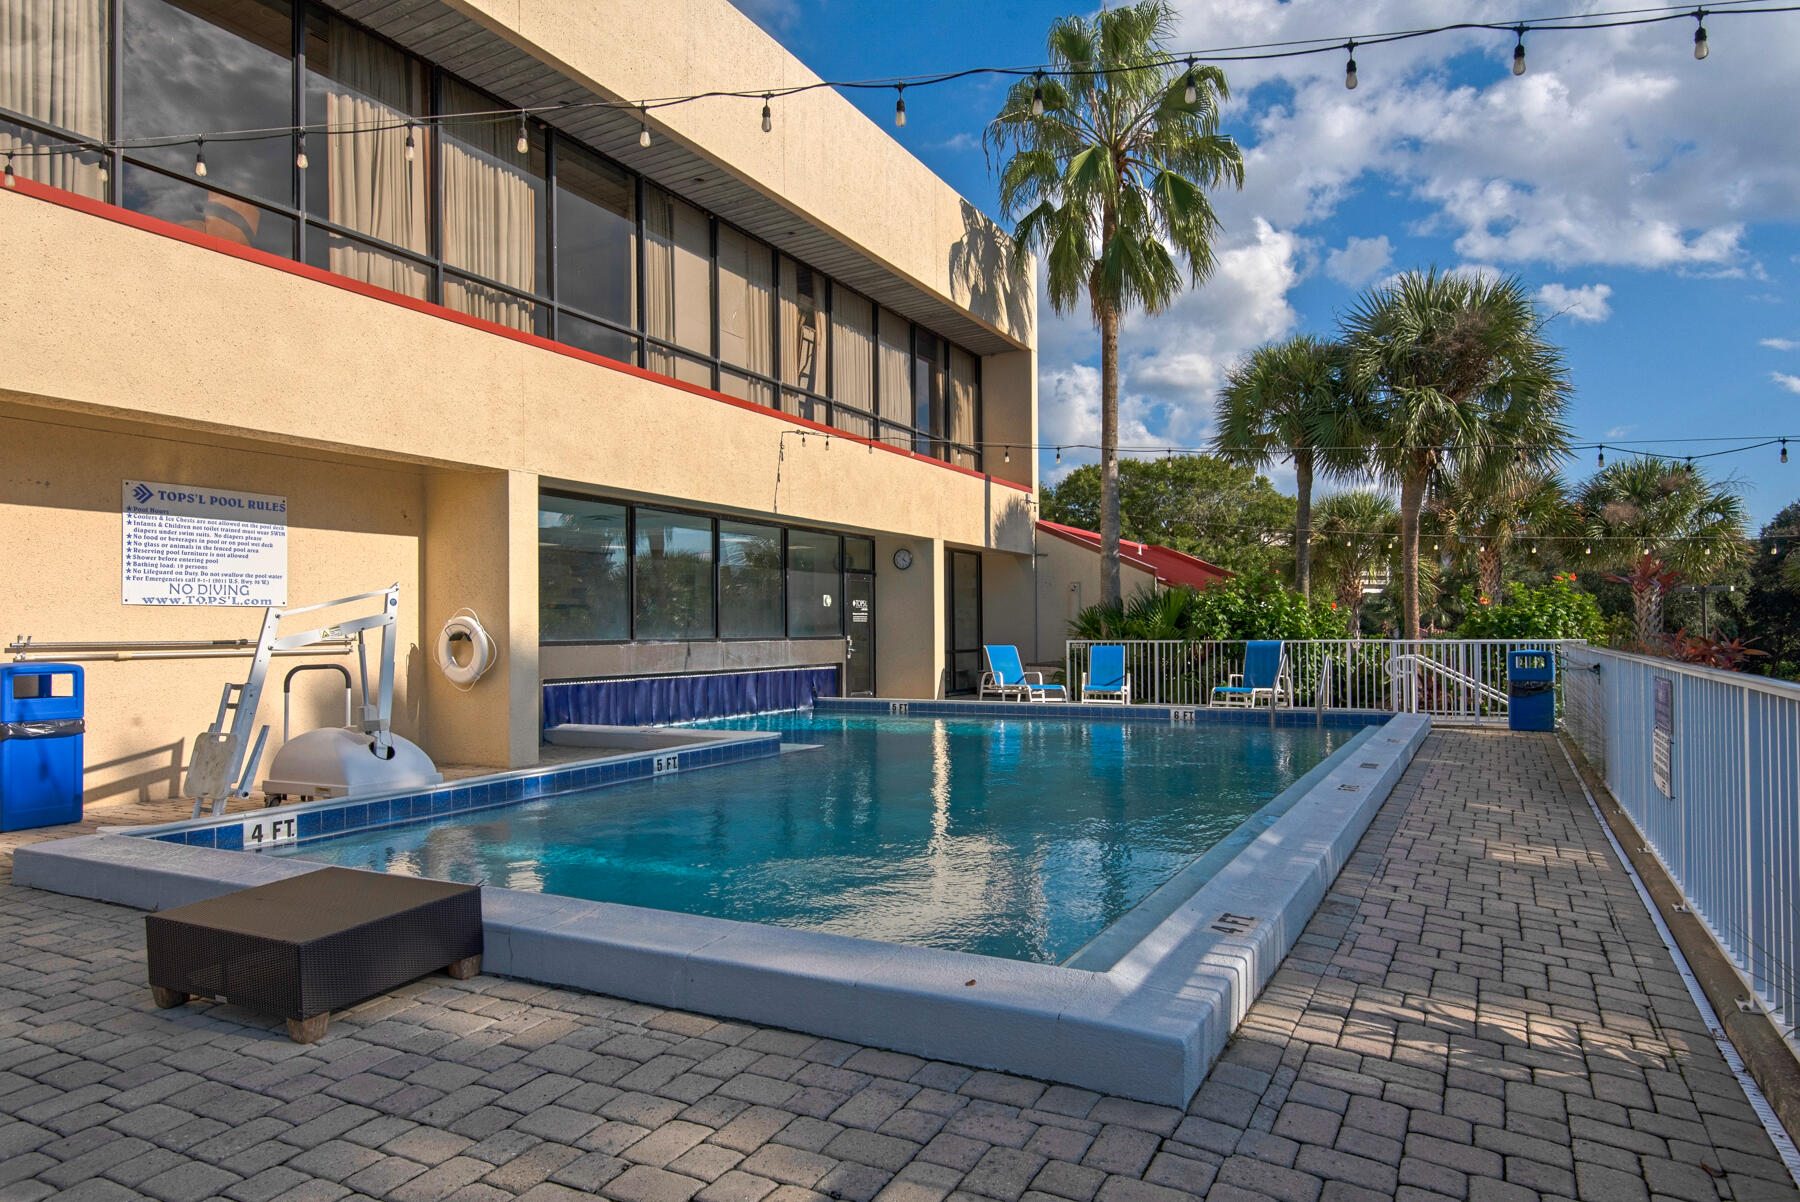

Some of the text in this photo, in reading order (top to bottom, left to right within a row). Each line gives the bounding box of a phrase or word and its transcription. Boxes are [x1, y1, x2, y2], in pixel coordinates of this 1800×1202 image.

[158, 490, 286, 512] TOPS'L POOL RULES
[170, 583, 249, 595] NO DIVING
[900, 703, 907, 711] FT
[657, 756, 677, 771] 5 FT
[252, 819, 294, 842] 4 FT.
